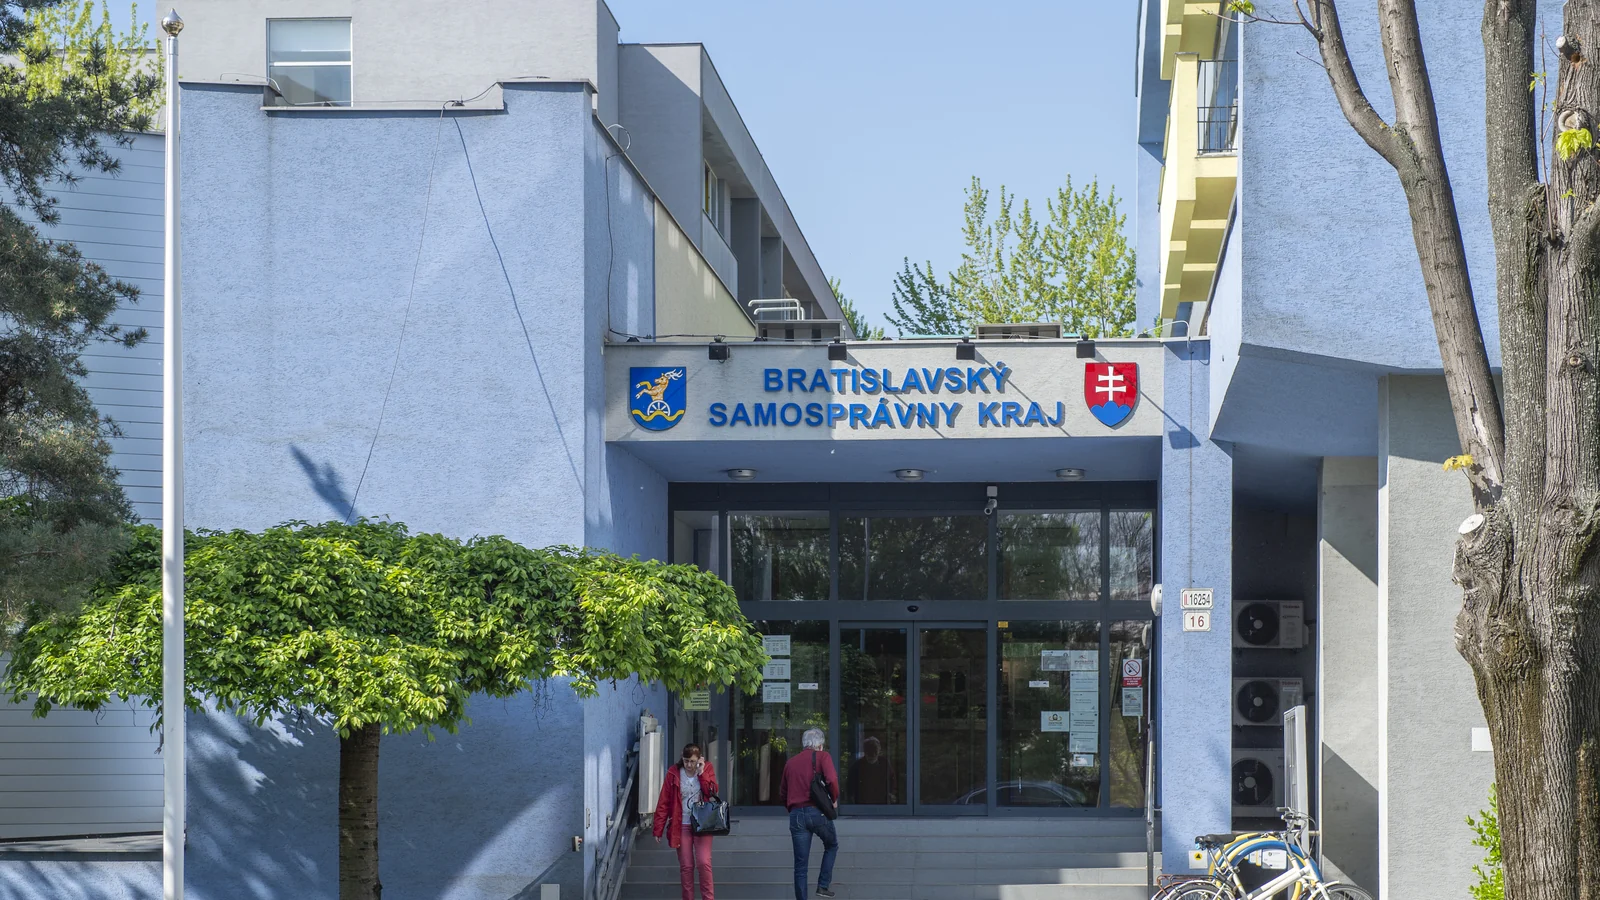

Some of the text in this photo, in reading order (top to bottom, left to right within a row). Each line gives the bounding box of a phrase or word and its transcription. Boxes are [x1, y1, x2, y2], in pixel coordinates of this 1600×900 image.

[765, 361, 1008, 394] BRATISLAVSKÝ
[709, 397, 1064, 427] SAMOSPRÁVNY KRAJ
[1190, 593, 1210, 606] 16254
[1190, 615, 1204, 627] 16
